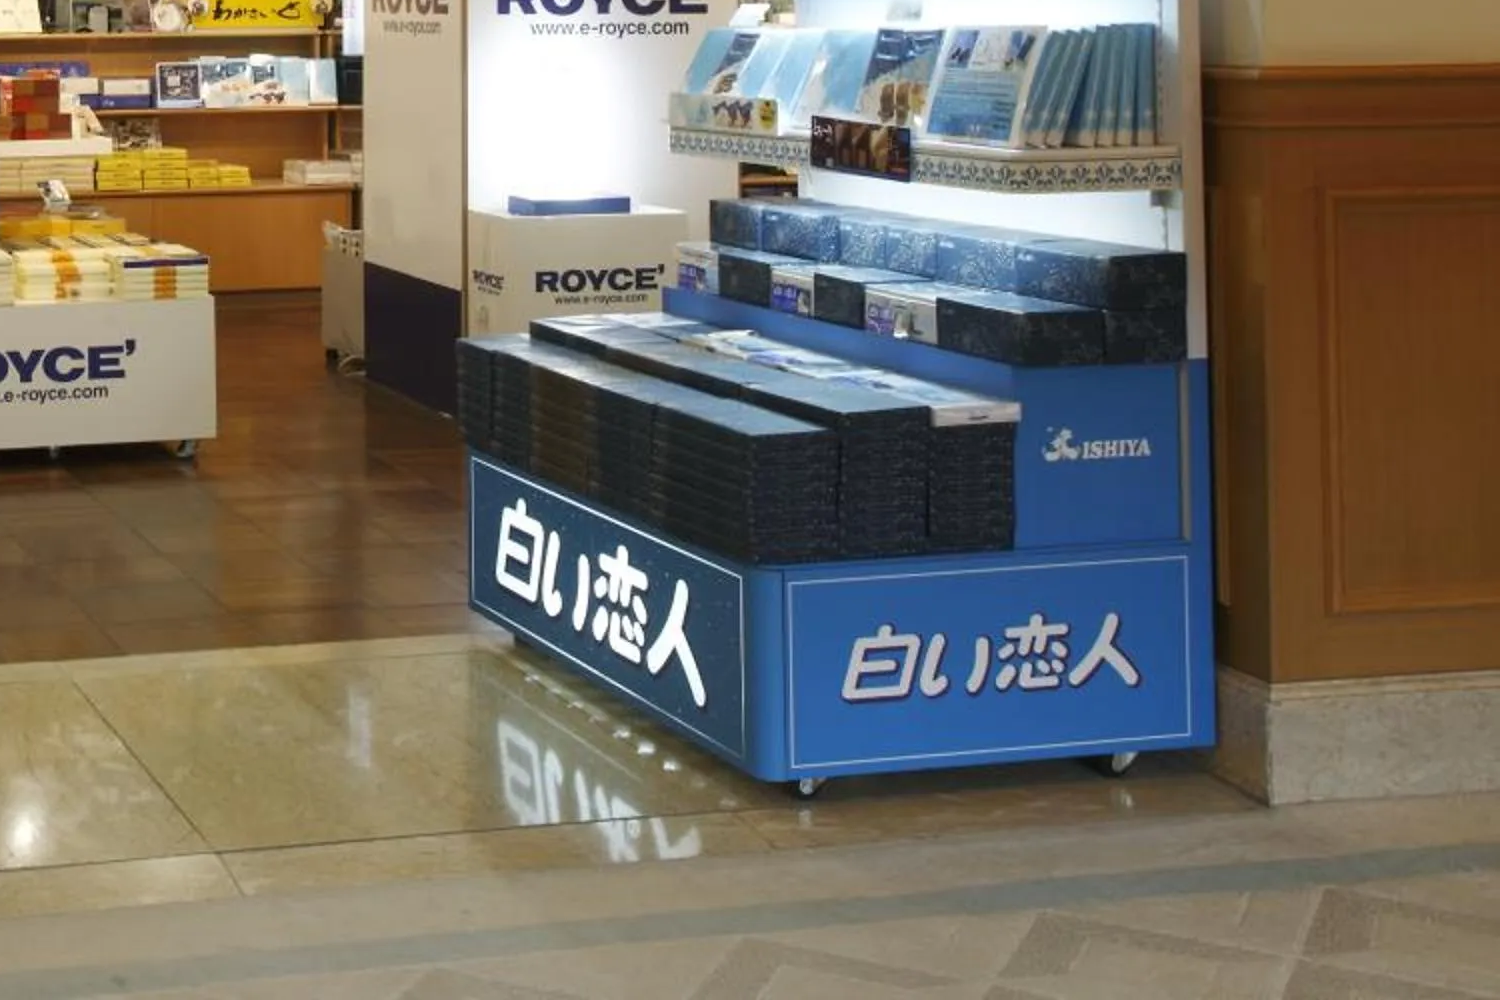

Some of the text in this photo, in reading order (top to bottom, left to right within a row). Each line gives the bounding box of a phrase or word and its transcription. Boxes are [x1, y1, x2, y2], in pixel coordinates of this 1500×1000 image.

[529, 21, 690, 39] www.e-royce.com
[534, 263, 665, 293] ROYCE'
[1081, 437, 1151, 461] ISHIYA
[495, 498, 707, 708] 白い恋人
[841, 612, 1141, 701] 白い恋人
